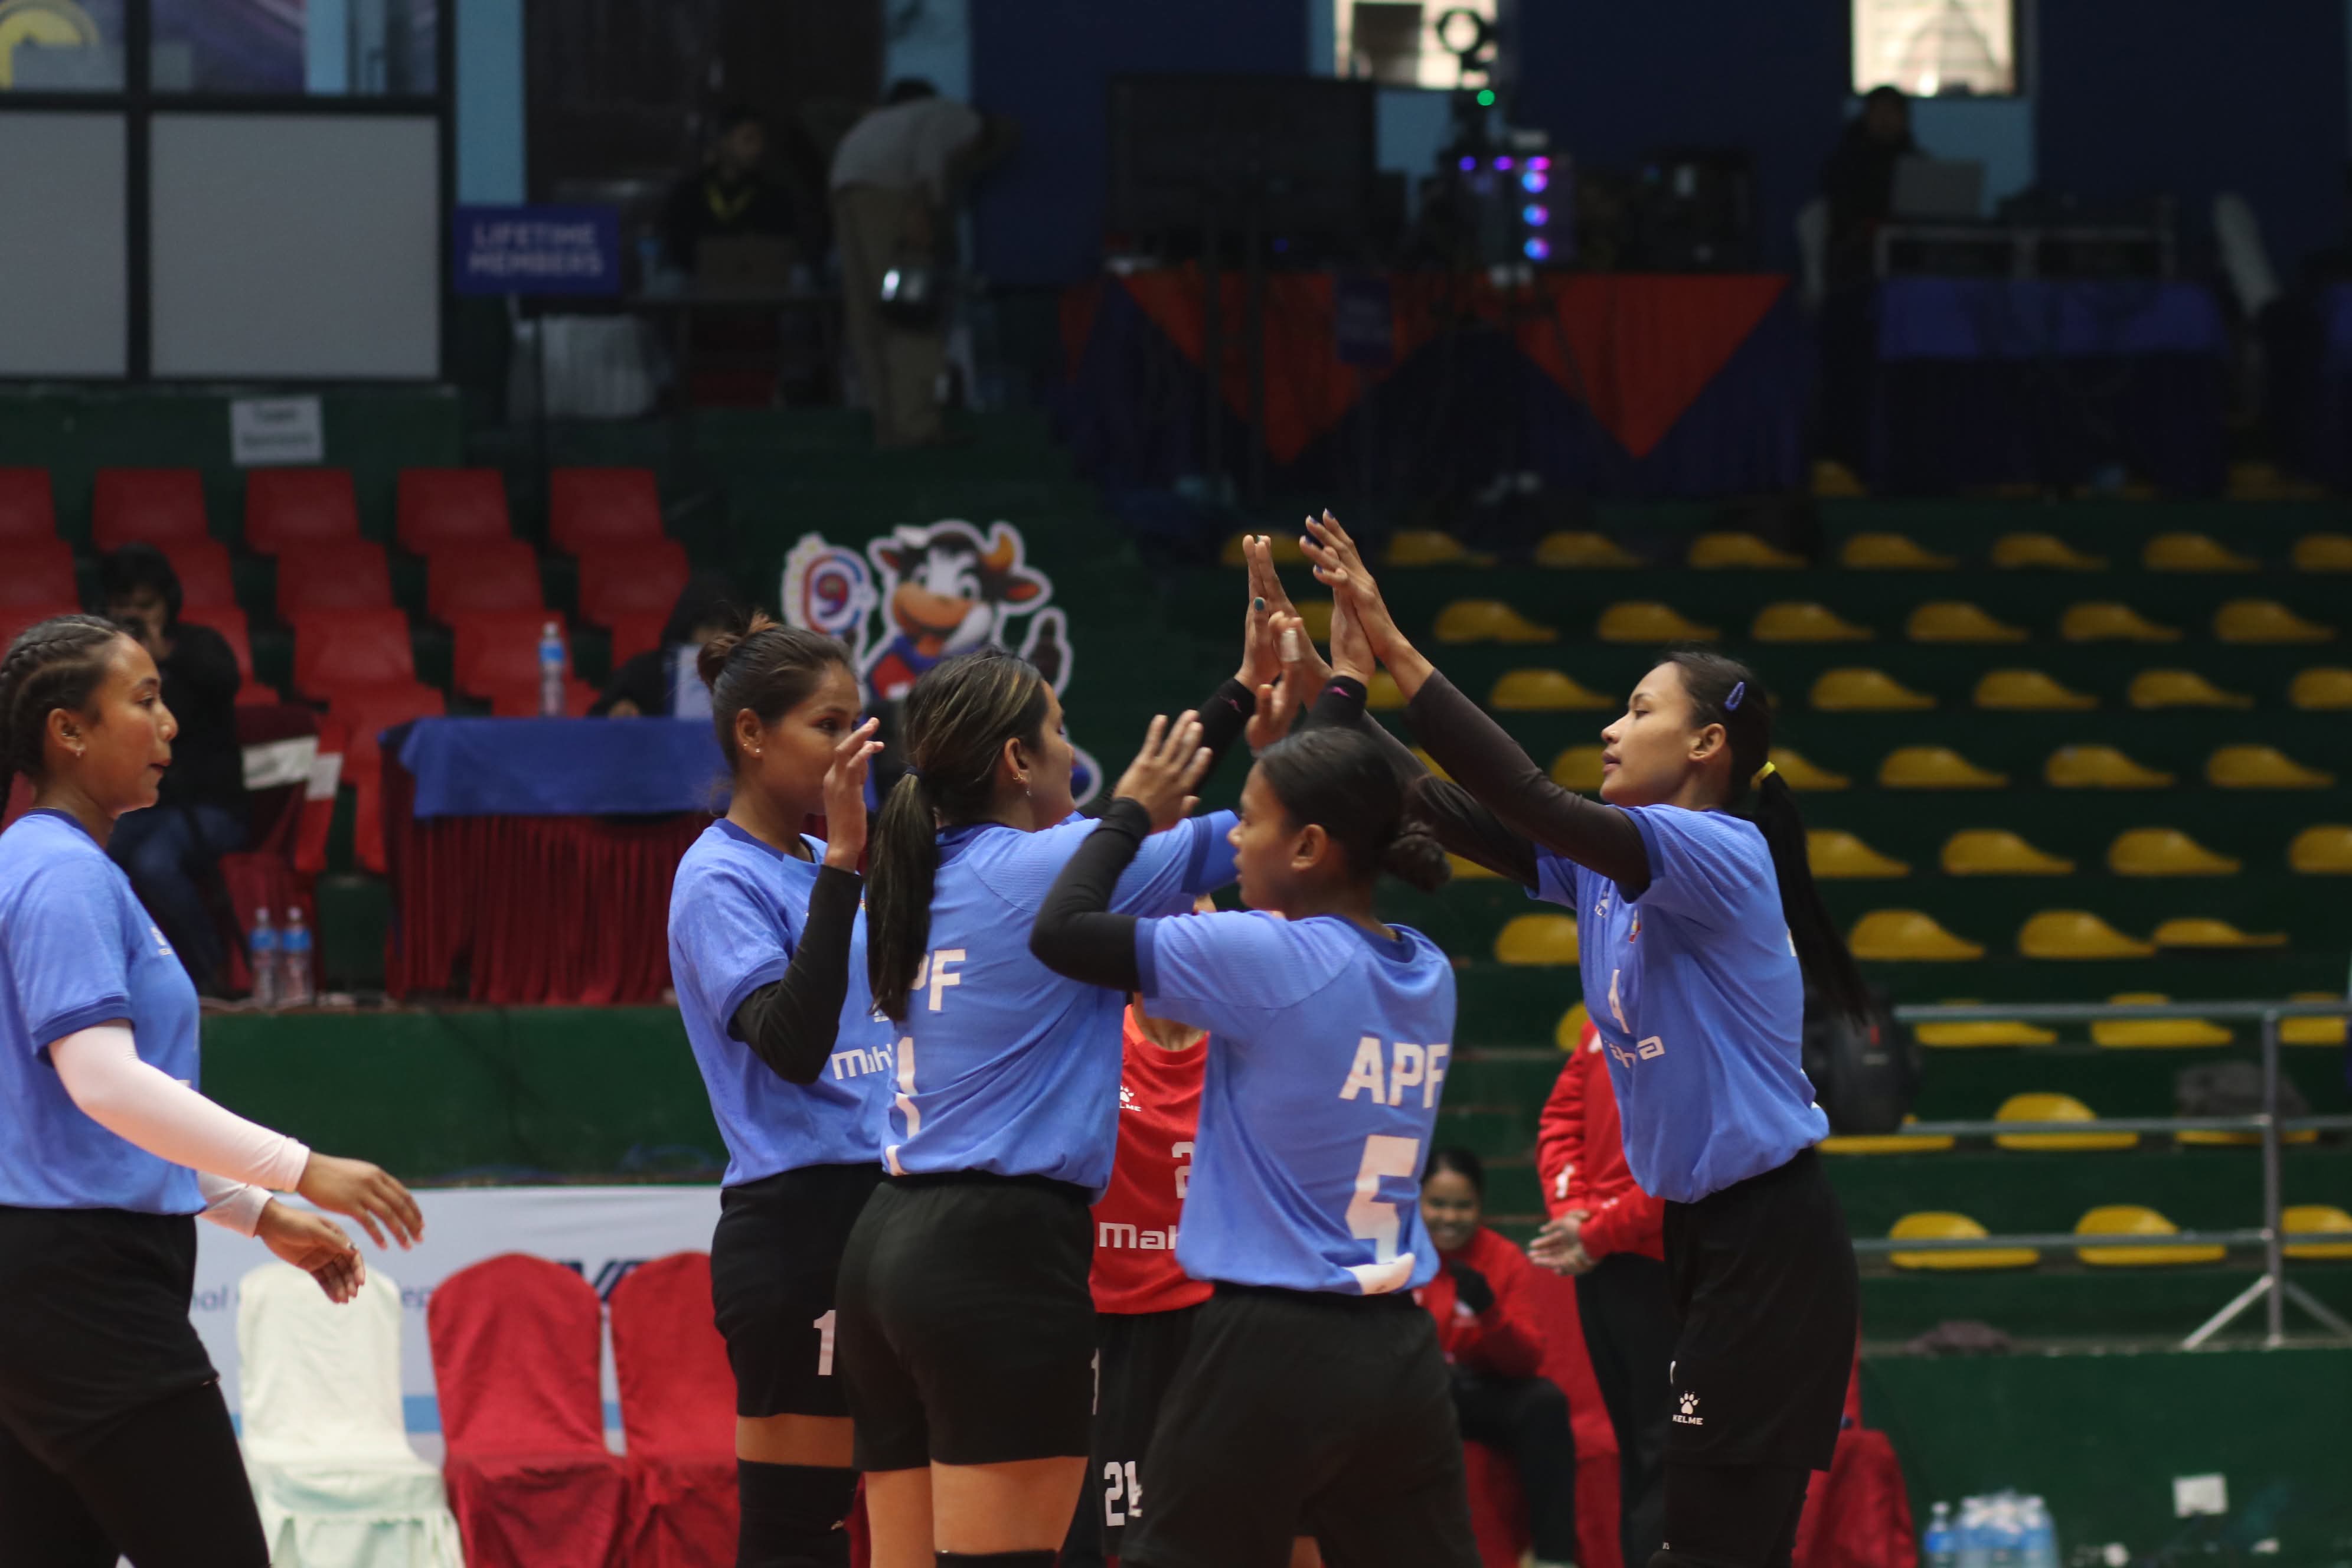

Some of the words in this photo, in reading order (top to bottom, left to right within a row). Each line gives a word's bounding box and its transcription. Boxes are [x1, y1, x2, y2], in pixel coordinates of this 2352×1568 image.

[471, 221, 596, 246] LIFETIME
[469, 251, 603, 276] MEMBERS
[1338, 1037, 1449, 1108] APF
[1345, 1134, 1420, 1295] 5
[1672, 1414, 1704, 1425] KELME
